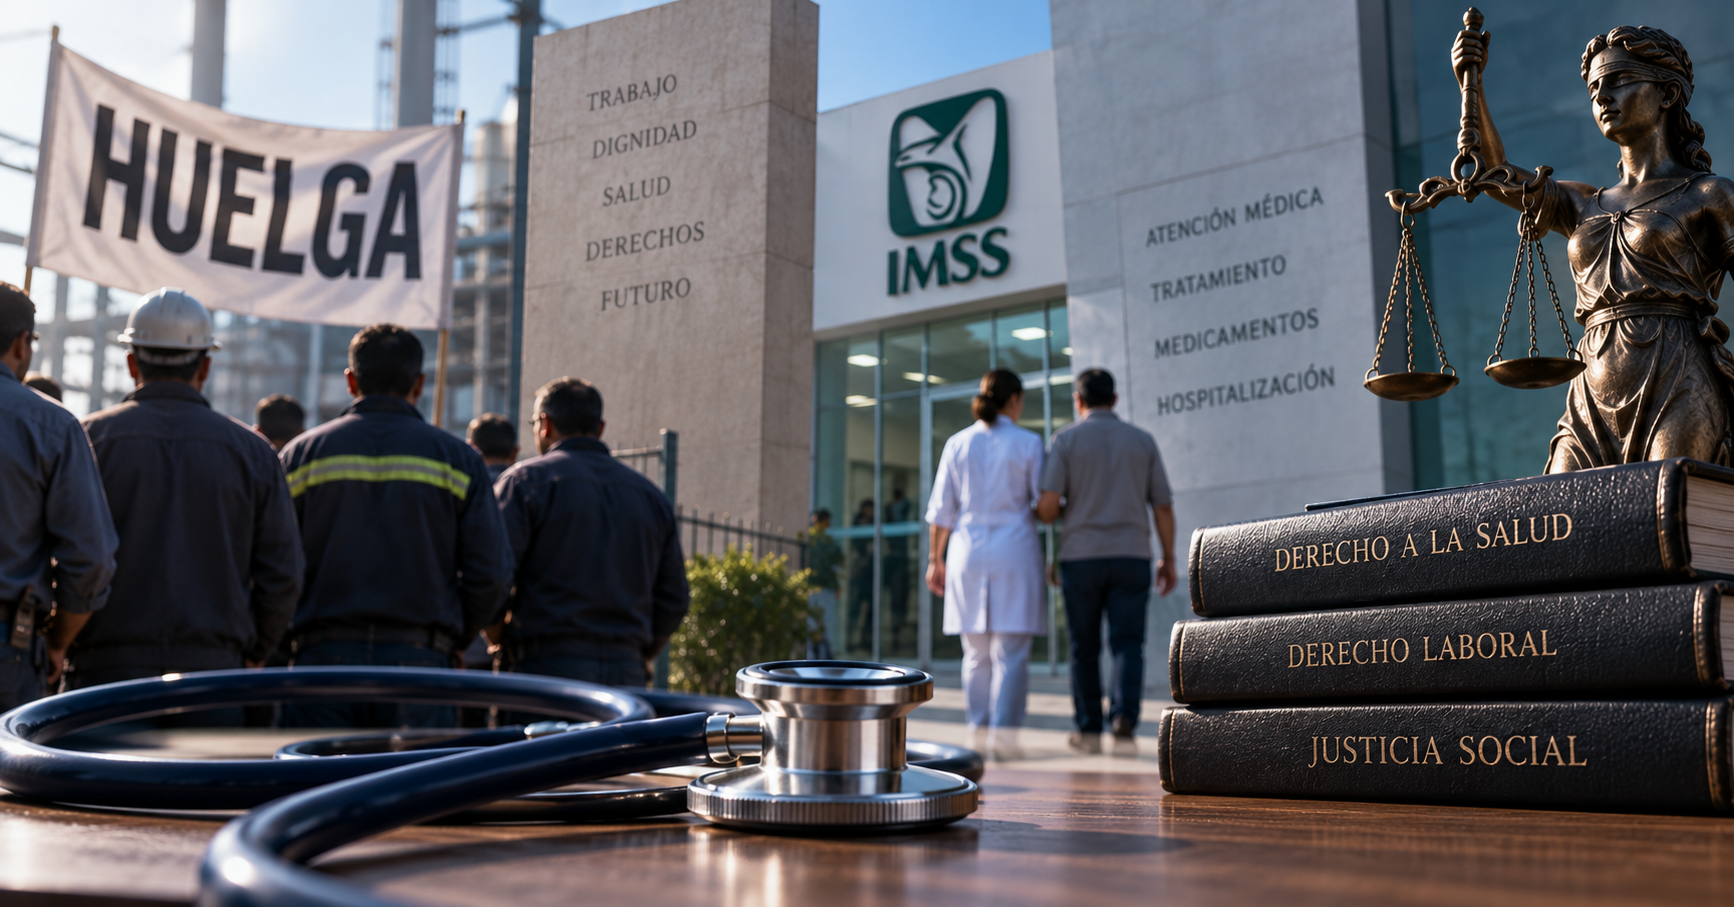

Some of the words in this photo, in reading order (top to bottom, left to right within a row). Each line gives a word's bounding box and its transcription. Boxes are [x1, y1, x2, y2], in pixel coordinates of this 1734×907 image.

[587, 74, 678, 112] TRABAJO
[592, 119, 698, 159] DIGNIDAD
[83, 103, 423, 281] HUELGA
[602, 176, 671, 207] SALUD
[1146, 207, 1236, 247] ATENCIÓN
[1245, 186, 1324, 223] MÉDICA
[585, 221, 705, 262] DERECHOS
[887, 227, 1010, 296] IMSS
[600, 277, 691, 312] FUTURO
[1151, 254, 1287, 302] TRATAMIENTO
[1154, 308, 1319, 359] MEDICAMENTOS
[1157, 363, 1335, 416] HOSPITALIZACIÓN
[1275, 535, 1389, 573] DERECHO
[1401, 534, 1419, 558] A
[1430, 526, 1464, 555] LA
[1476, 513, 1573, 549] SALUD
[1288, 637, 1410, 669] DERECHO
[1423, 630, 1557, 662] LABORAL
[1308, 736, 1443, 768] JUSTICIA
[1459, 735, 1588, 767] SOCIAL
